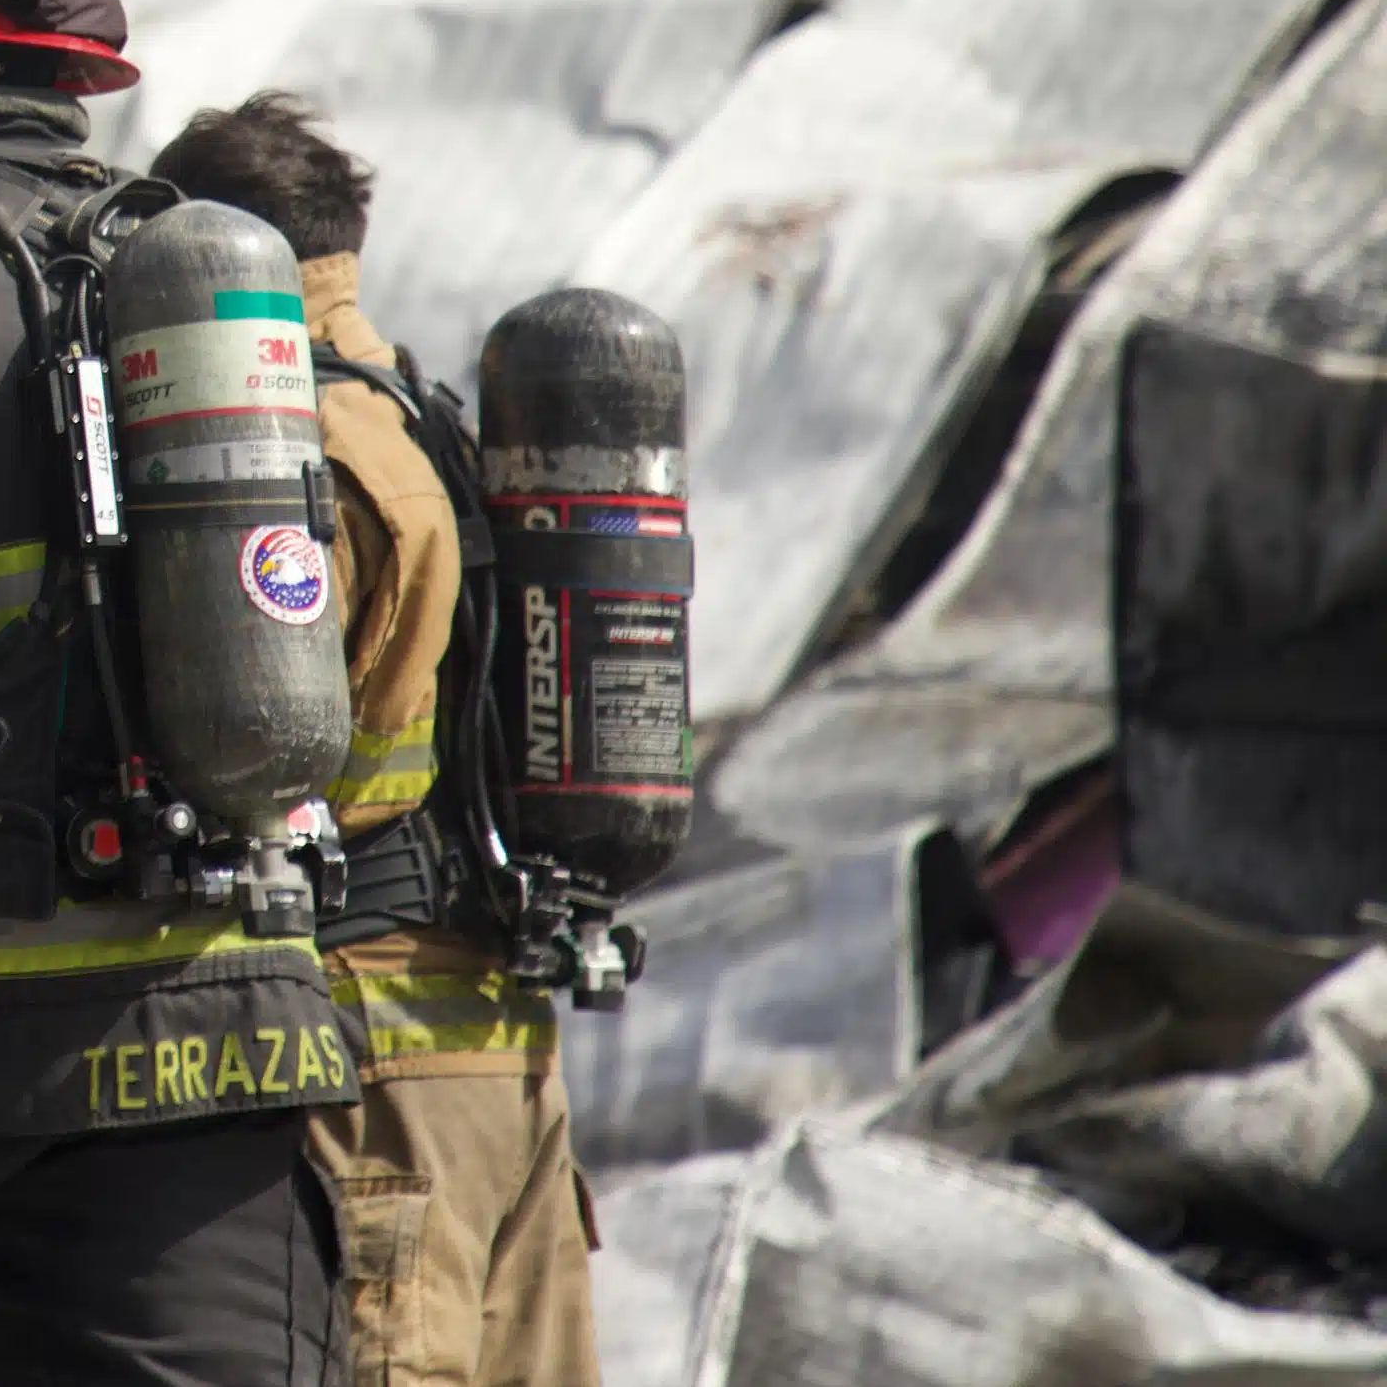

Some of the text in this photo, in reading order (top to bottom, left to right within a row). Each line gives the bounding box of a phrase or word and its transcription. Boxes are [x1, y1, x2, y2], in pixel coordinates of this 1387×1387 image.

[121, 349, 158, 382] 3M
[257, 336, 299, 368] 3M
[125, 382, 175, 408] SCOTT
[262, 374, 308, 392] SCOTT
[93, 420, 111, 476] SCOTT
[82, 1024, 347, 1113] TERRAZAS
